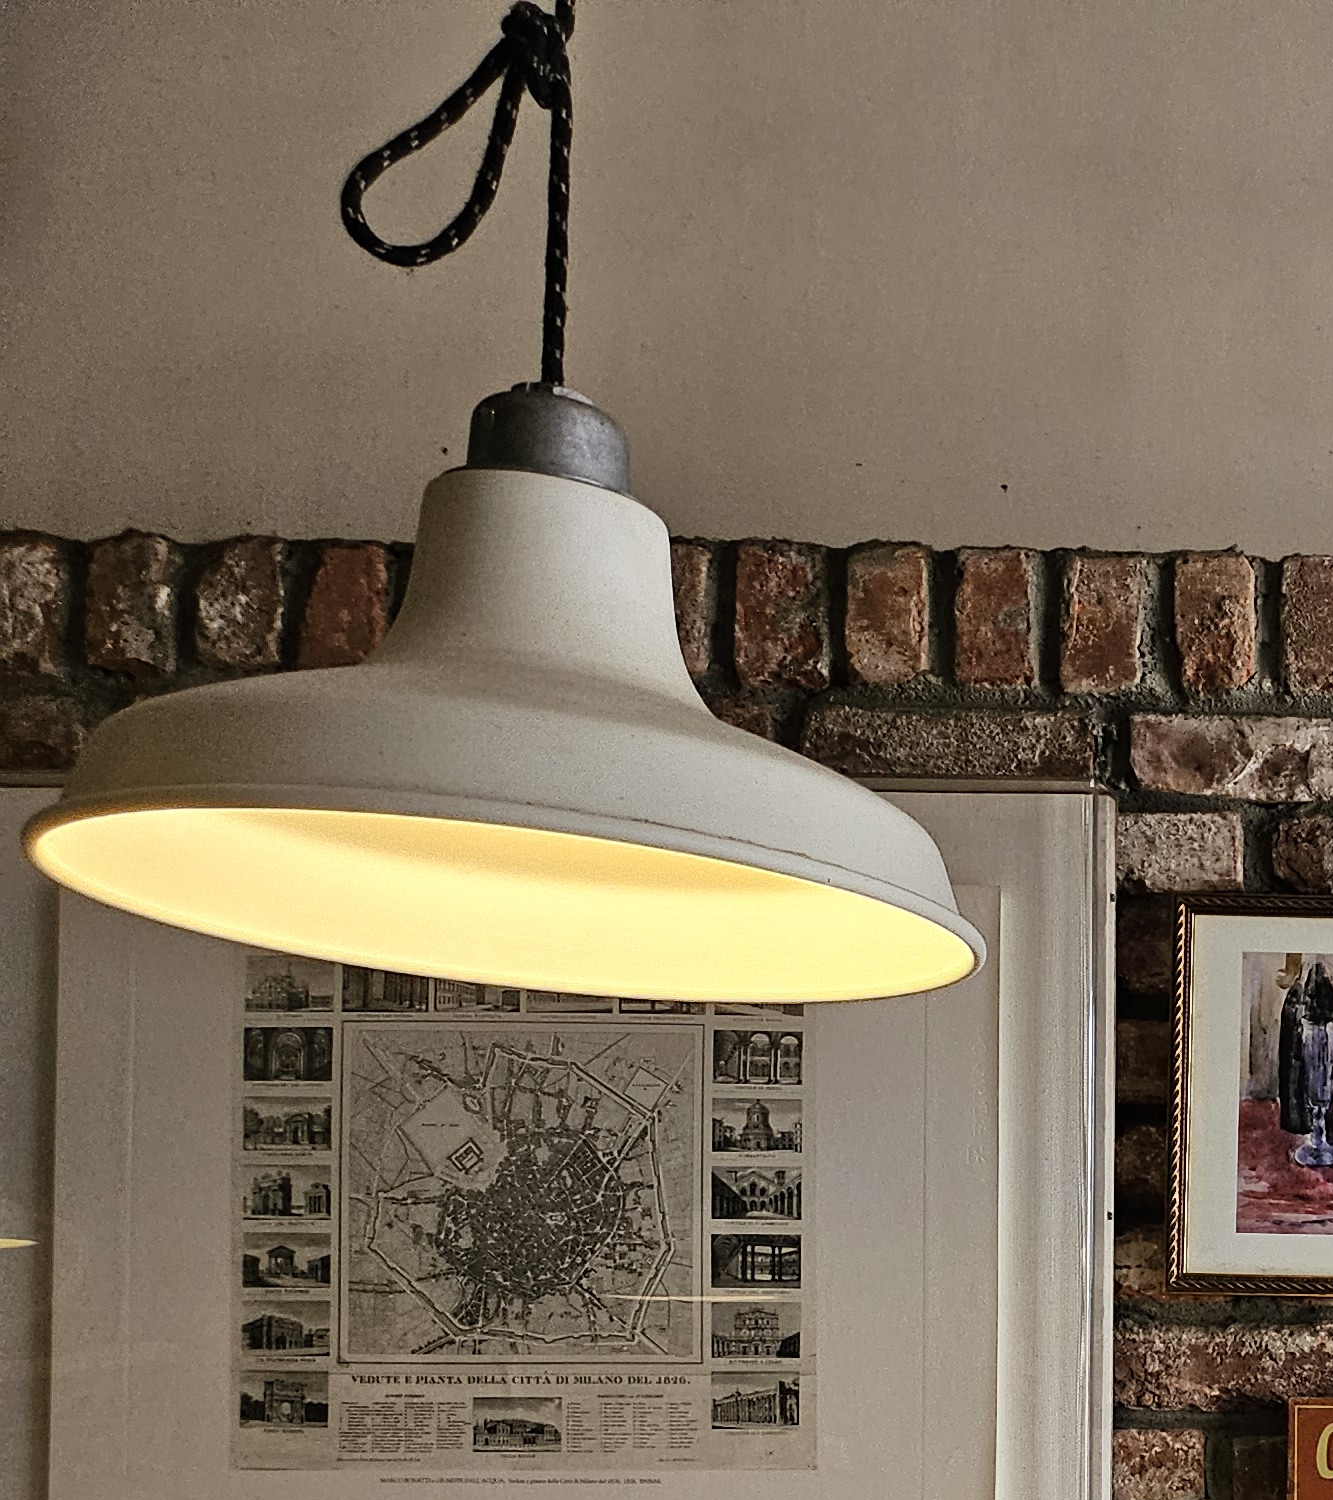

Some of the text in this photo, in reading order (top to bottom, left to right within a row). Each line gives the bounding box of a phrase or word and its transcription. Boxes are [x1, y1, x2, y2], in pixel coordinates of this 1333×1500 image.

[351, 1375, 400, 1384] VEDUTE
[405, 1375, 412, 1384] E
[415, 1375, 462, 1384] PIANTA
[467, 1375, 507, 1384] DELLA
[556, 1376, 569, 1384] DI
[573, 1376, 623, 1384] MILANO
[627, 1376, 652, 1384] DEL
